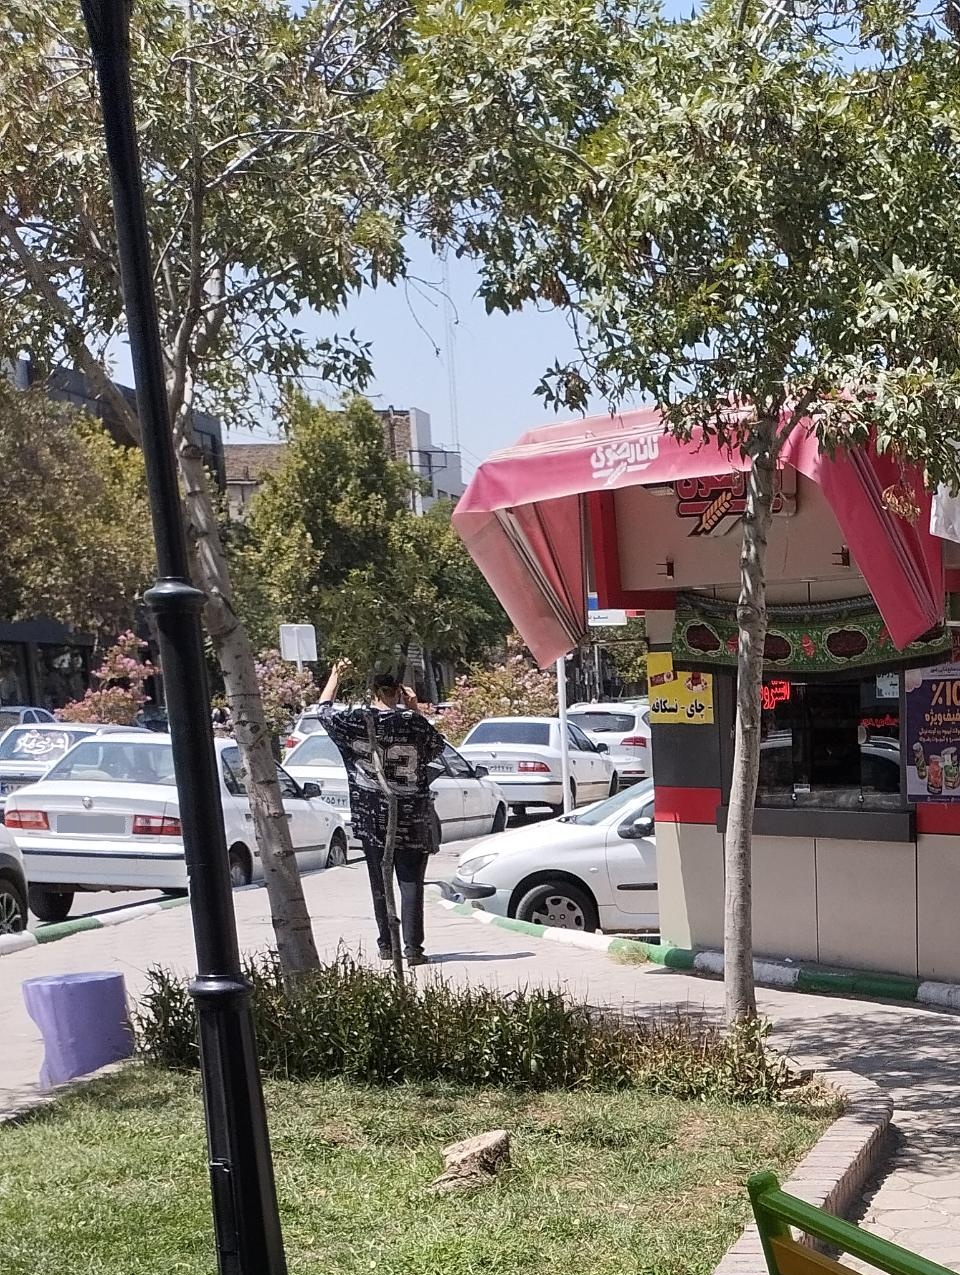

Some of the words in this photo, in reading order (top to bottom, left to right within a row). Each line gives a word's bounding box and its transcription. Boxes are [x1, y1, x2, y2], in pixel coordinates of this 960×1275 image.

[590, 441, 636, 469] رضوی
[636, 434, 659, 461] نان
[652, 698, 678, 713] نسکافه
[686, 699, 705, 719] چای
[924, 708, 943, 726] ویژه
